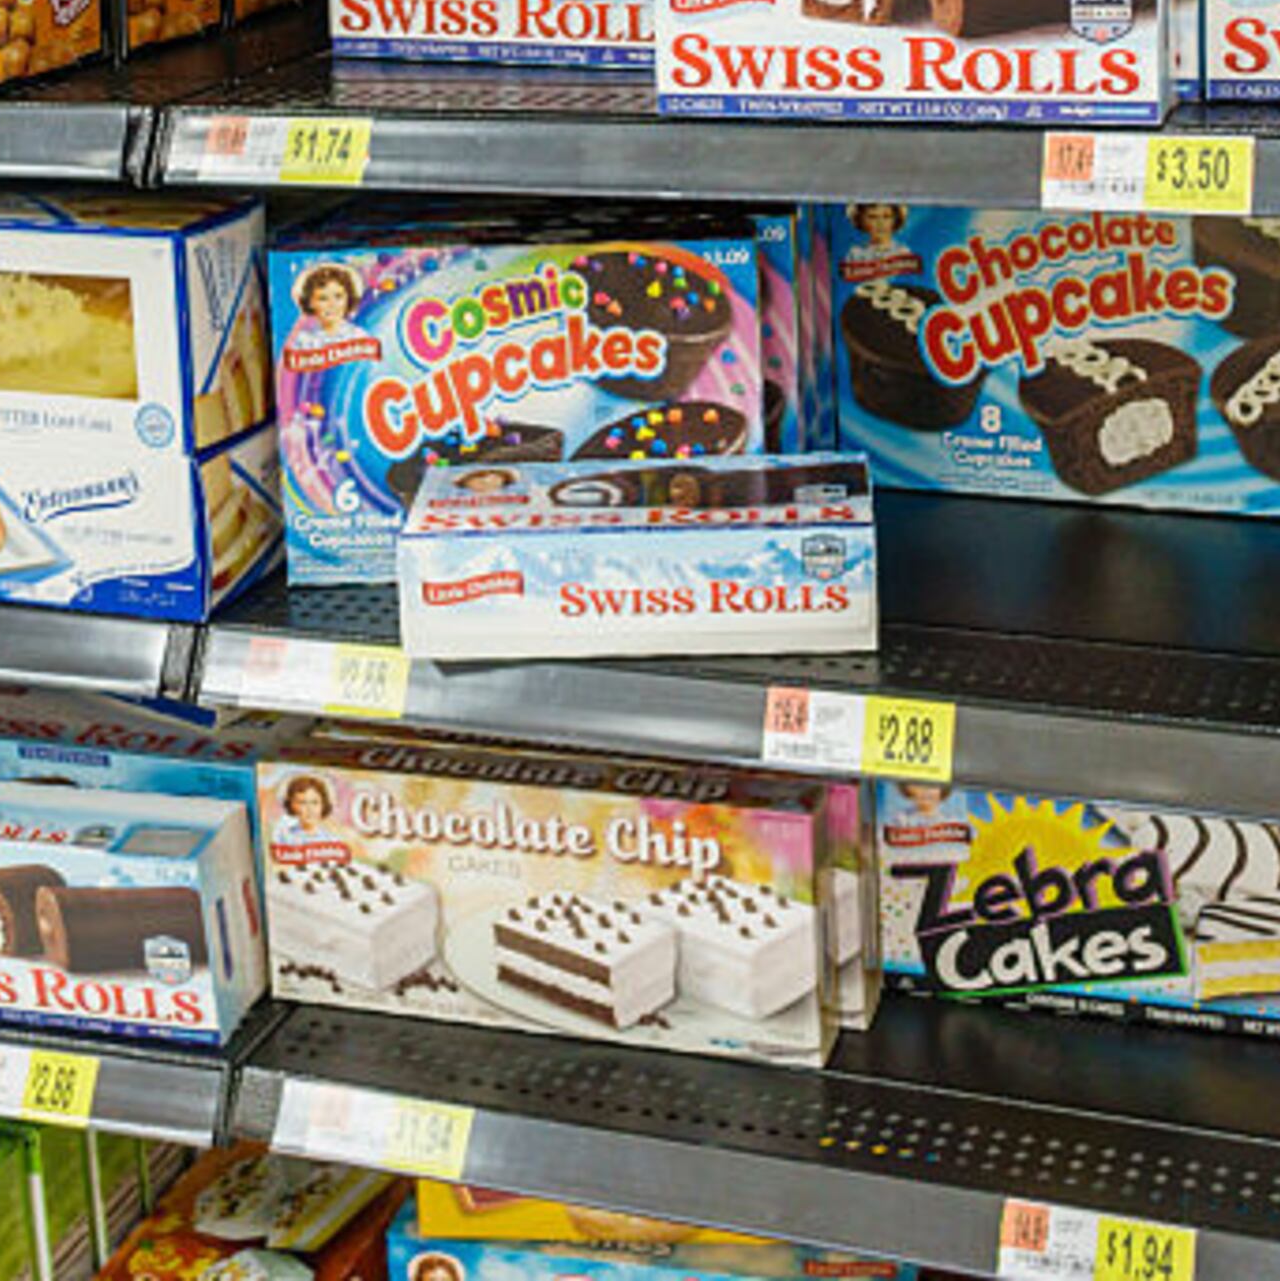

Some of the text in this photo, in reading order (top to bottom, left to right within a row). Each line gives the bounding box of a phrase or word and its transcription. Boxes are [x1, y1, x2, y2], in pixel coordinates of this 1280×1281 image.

[670, 33, 886, 94] SWISS
[904, 37, 1141, 95] ROLLS
[291, 124, 353, 165] $1.74
[1157, 146, 1231, 191] $3.50
[936, 213, 1176, 306] Chocolate
[406, 266, 587, 362] Cosmic
[924, 253, 1230, 381] Cupcakes
[365, 318, 663, 454] Cupcakes
[980, 405, 1001, 433] 8
[23, 471, 140, 522] Entenmann's
[335, 478, 361, 513] 6
[426, 583, 467, 605] Little
[560, 579, 850, 618] SWISS ROLLS
[878, 716, 933, 763] $2.88
[360, 743, 731, 801] Chocolate Chip
[350, 792, 721, 871] Chocolate Chip
[889, 845, 1176, 930] Zebra
[934, 922, 1169, 991] Cakes
[30, 966, 204, 1027] ROLLS
[1106, 1230, 1174, 1281] $1.94
